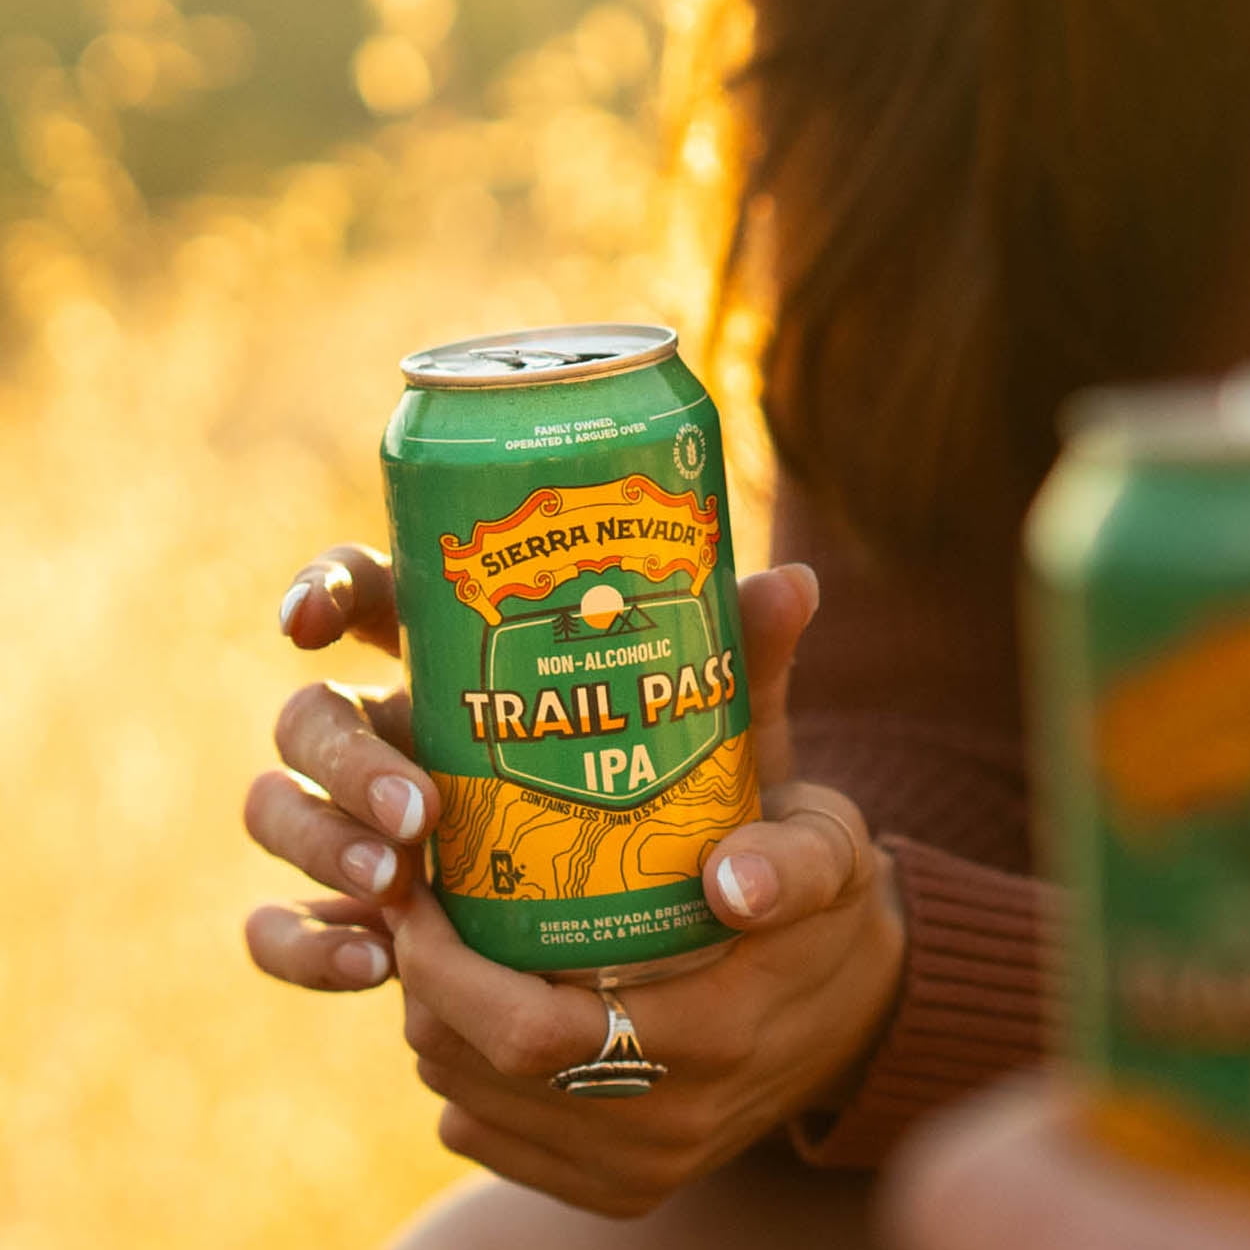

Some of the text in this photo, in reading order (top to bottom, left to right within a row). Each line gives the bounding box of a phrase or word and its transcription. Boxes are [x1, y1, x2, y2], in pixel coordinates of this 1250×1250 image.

[505, 422, 647, 450] OPERATED & ARGUED OVER
[533, 417, 617, 436] FAMILY OWNED,
[481, 524, 589, 578] SIERRA
[537, 639, 672, 676] NON-ALCOHOLIC
[462, 648, 736, 743] TRAIL PASS
[583, 744, 657, 794] IPA
[520, 790, 571, 816] CONTAINS
[573, 806, 600, 823] LESS
[603, 812, 632, 826] THAN
[540, 900, 706, 932] SIERRA NEVADA BREWIN
[541, 931, 590, 944] CHICO,
[594, 929, 613, 941] CA
[616, 927, 626, 938] &
[630, 919, 671, 936] MILLS
